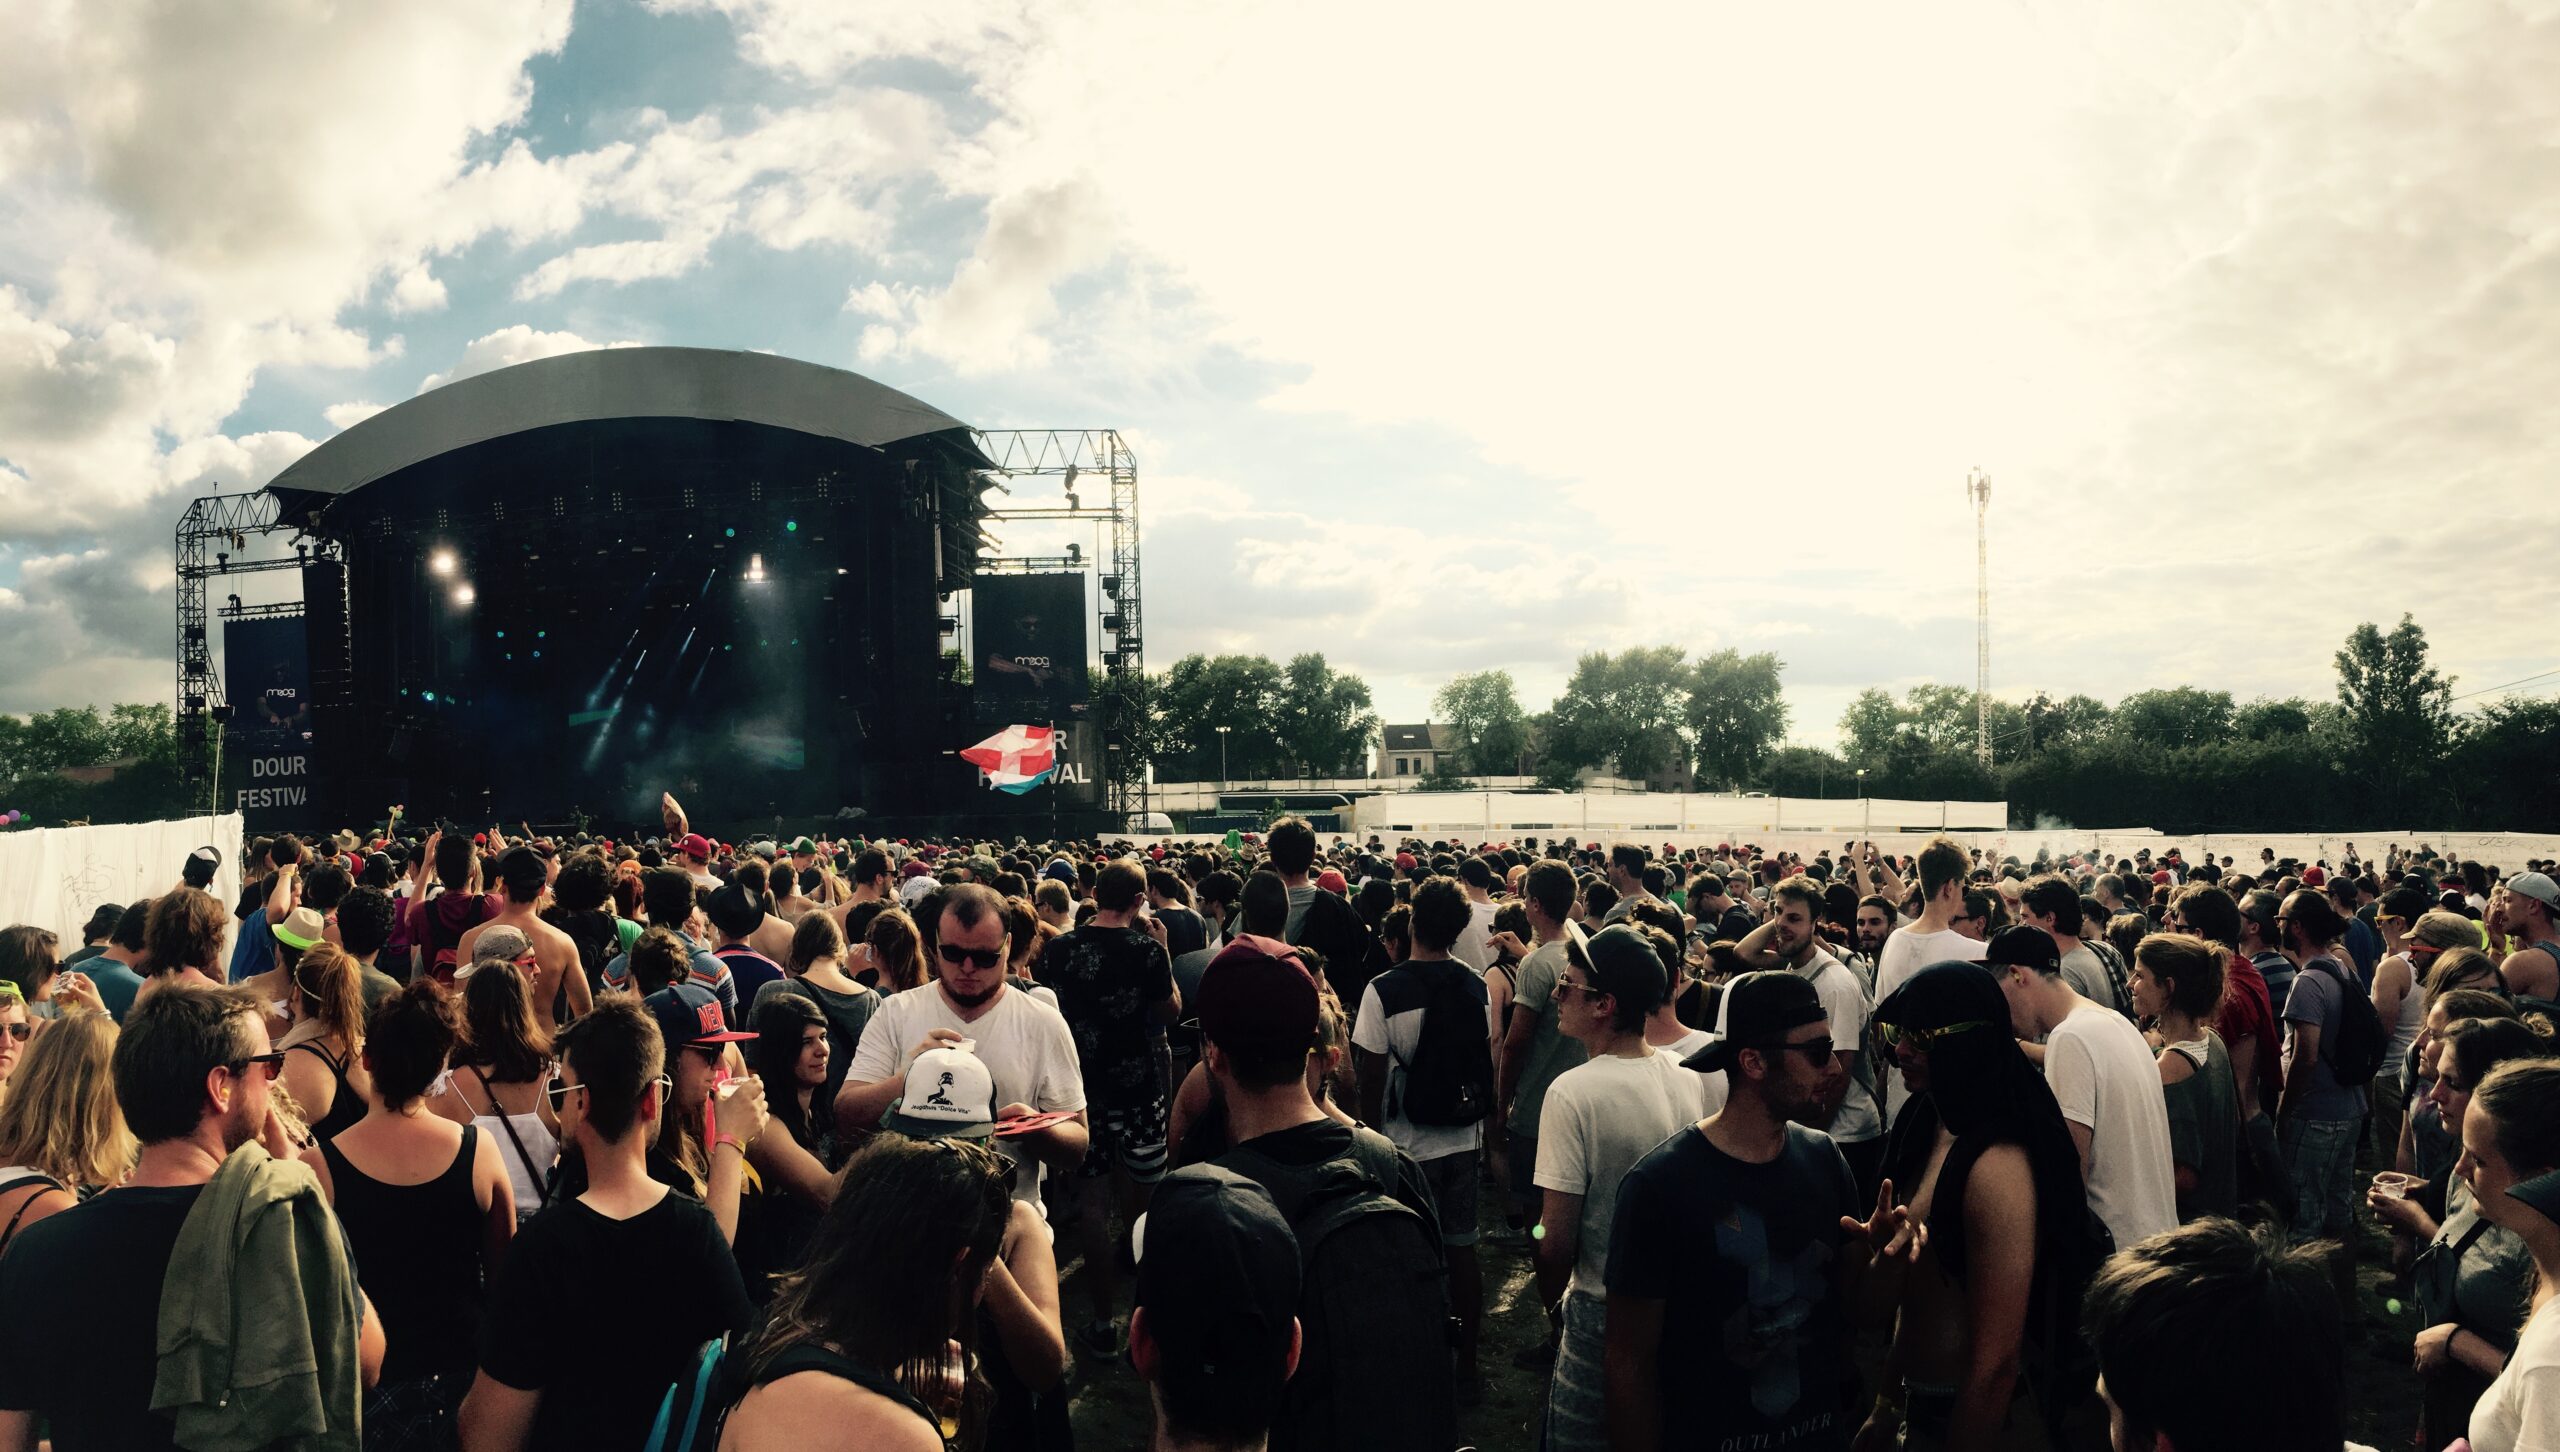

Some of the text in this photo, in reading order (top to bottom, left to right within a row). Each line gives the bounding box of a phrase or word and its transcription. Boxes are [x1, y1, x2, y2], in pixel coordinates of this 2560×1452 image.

[1014, 656, 1050, 668] moog
[266, 688, 296, 698] moog
[252, 755, 307, 778] DOUR
[237, 786, 307, 809] FESTIVA
